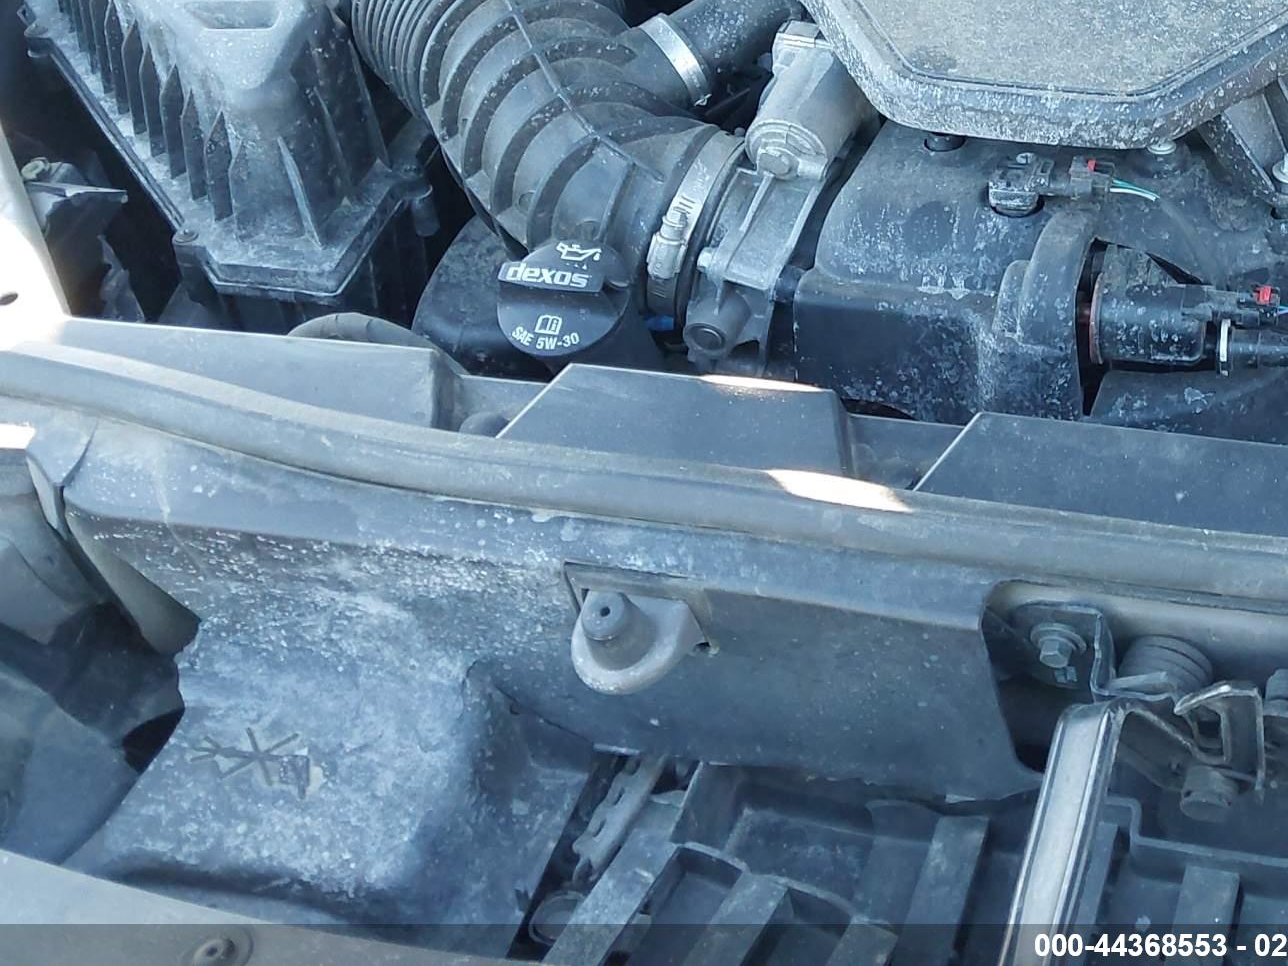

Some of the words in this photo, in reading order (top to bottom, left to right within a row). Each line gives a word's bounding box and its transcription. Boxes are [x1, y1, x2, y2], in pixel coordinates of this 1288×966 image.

[505, 262, 589, 288] dexos
[511, 326, 534, 346] SAE
[535, 332, 580, 350] 5W-30
